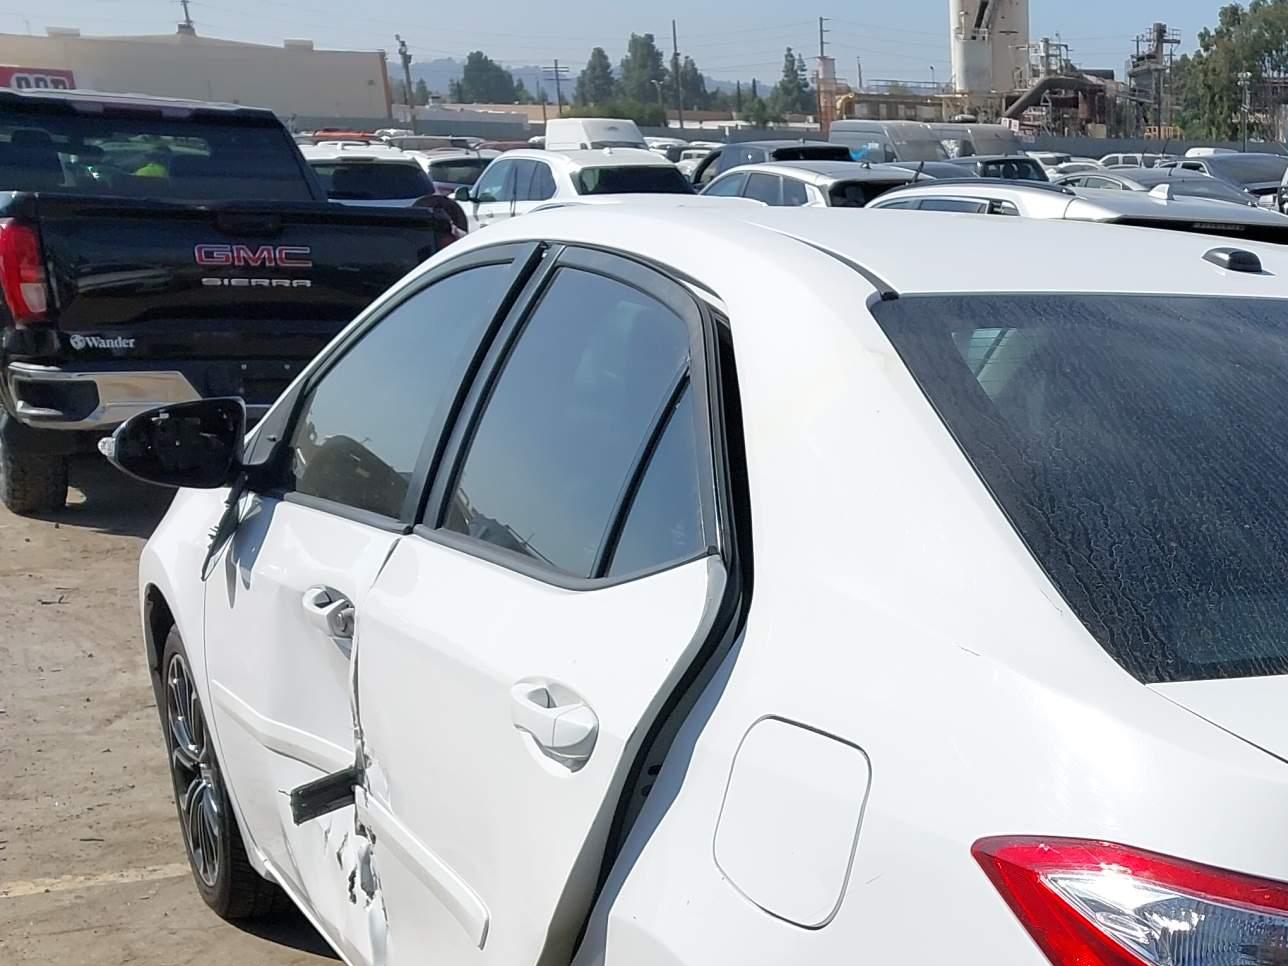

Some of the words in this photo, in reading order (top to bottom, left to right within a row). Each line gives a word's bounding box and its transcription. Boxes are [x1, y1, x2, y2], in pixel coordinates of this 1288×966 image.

[194, 244, 313, 267] GMC
[201, 277, 312, 288] SIERRA
[84, 336, 136, 349] Wander
